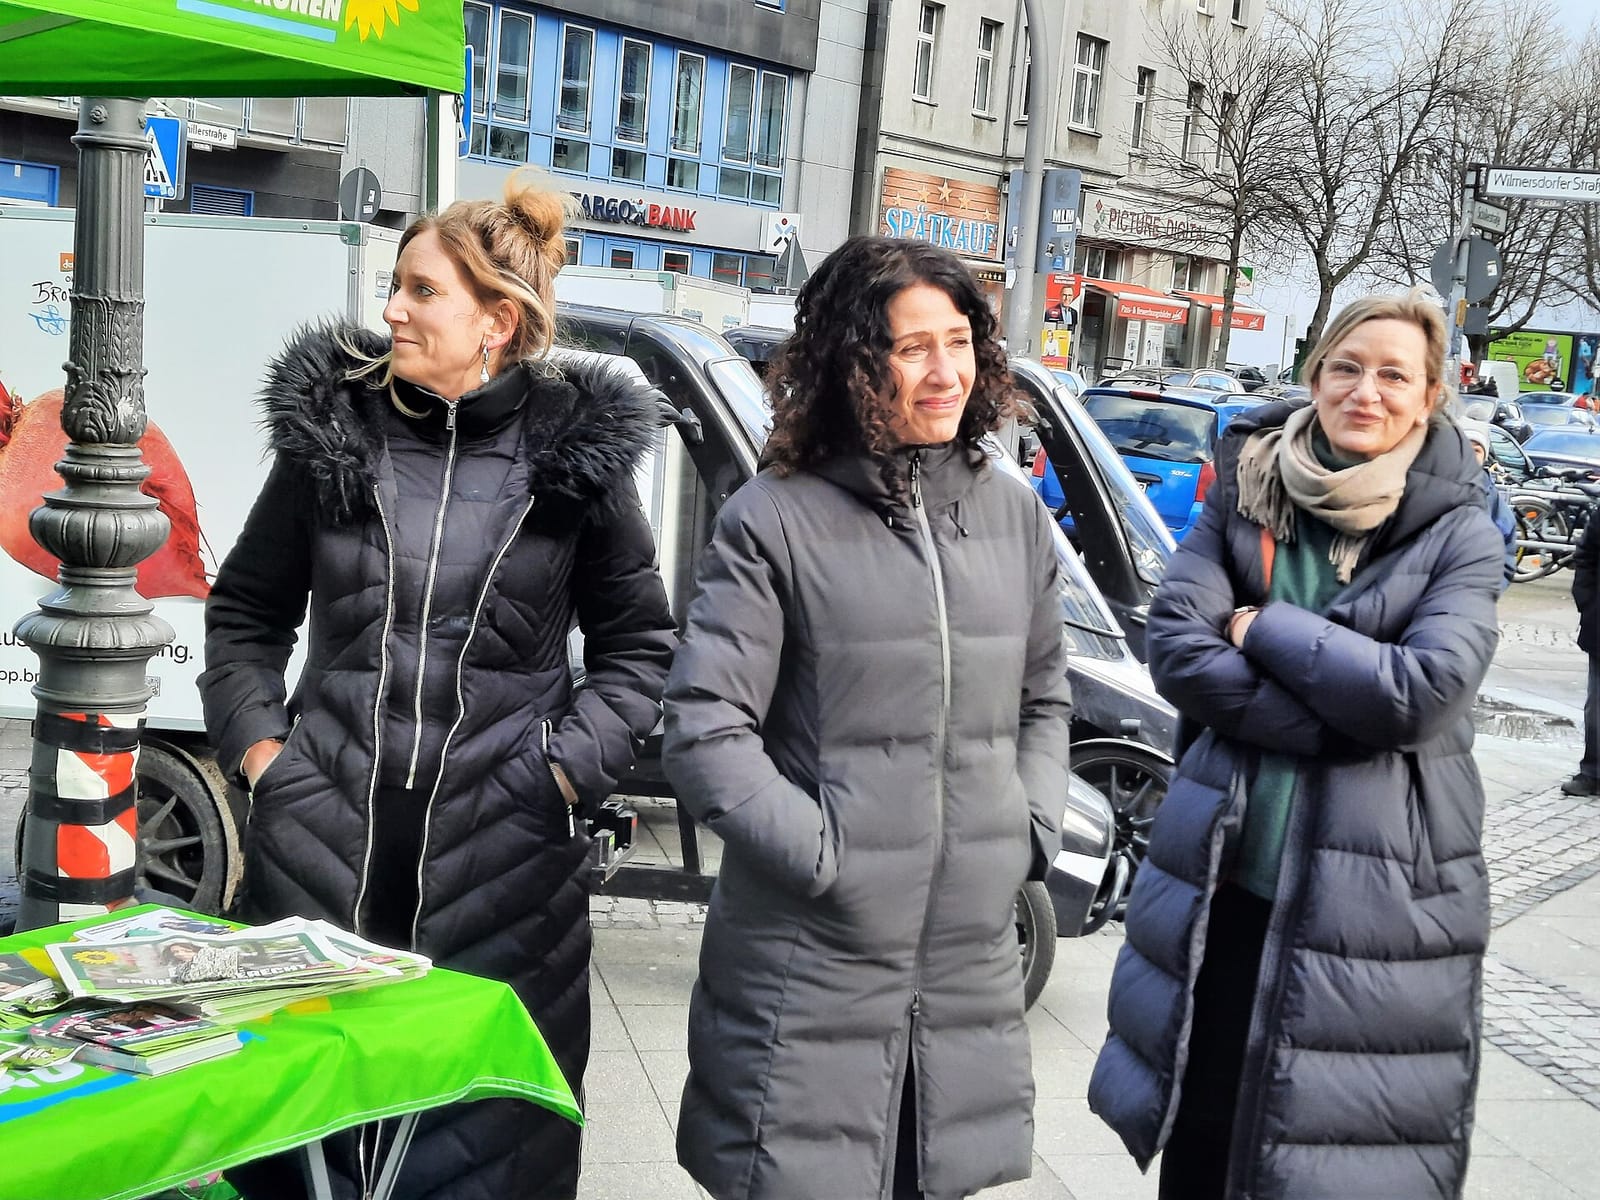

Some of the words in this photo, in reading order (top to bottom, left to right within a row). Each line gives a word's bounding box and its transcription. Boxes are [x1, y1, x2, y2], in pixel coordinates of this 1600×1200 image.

[1494, 173, 1571, 190] Wilmersdorfer
[649, 203, 697, 231] BANK
[885, 204, 995, 254] SPÄTKAUF
[1109, 207, 1161, 237] PICTURE
[32, 281, 72, 304] BRO
[234, 964, 307, 979] ERECHT
